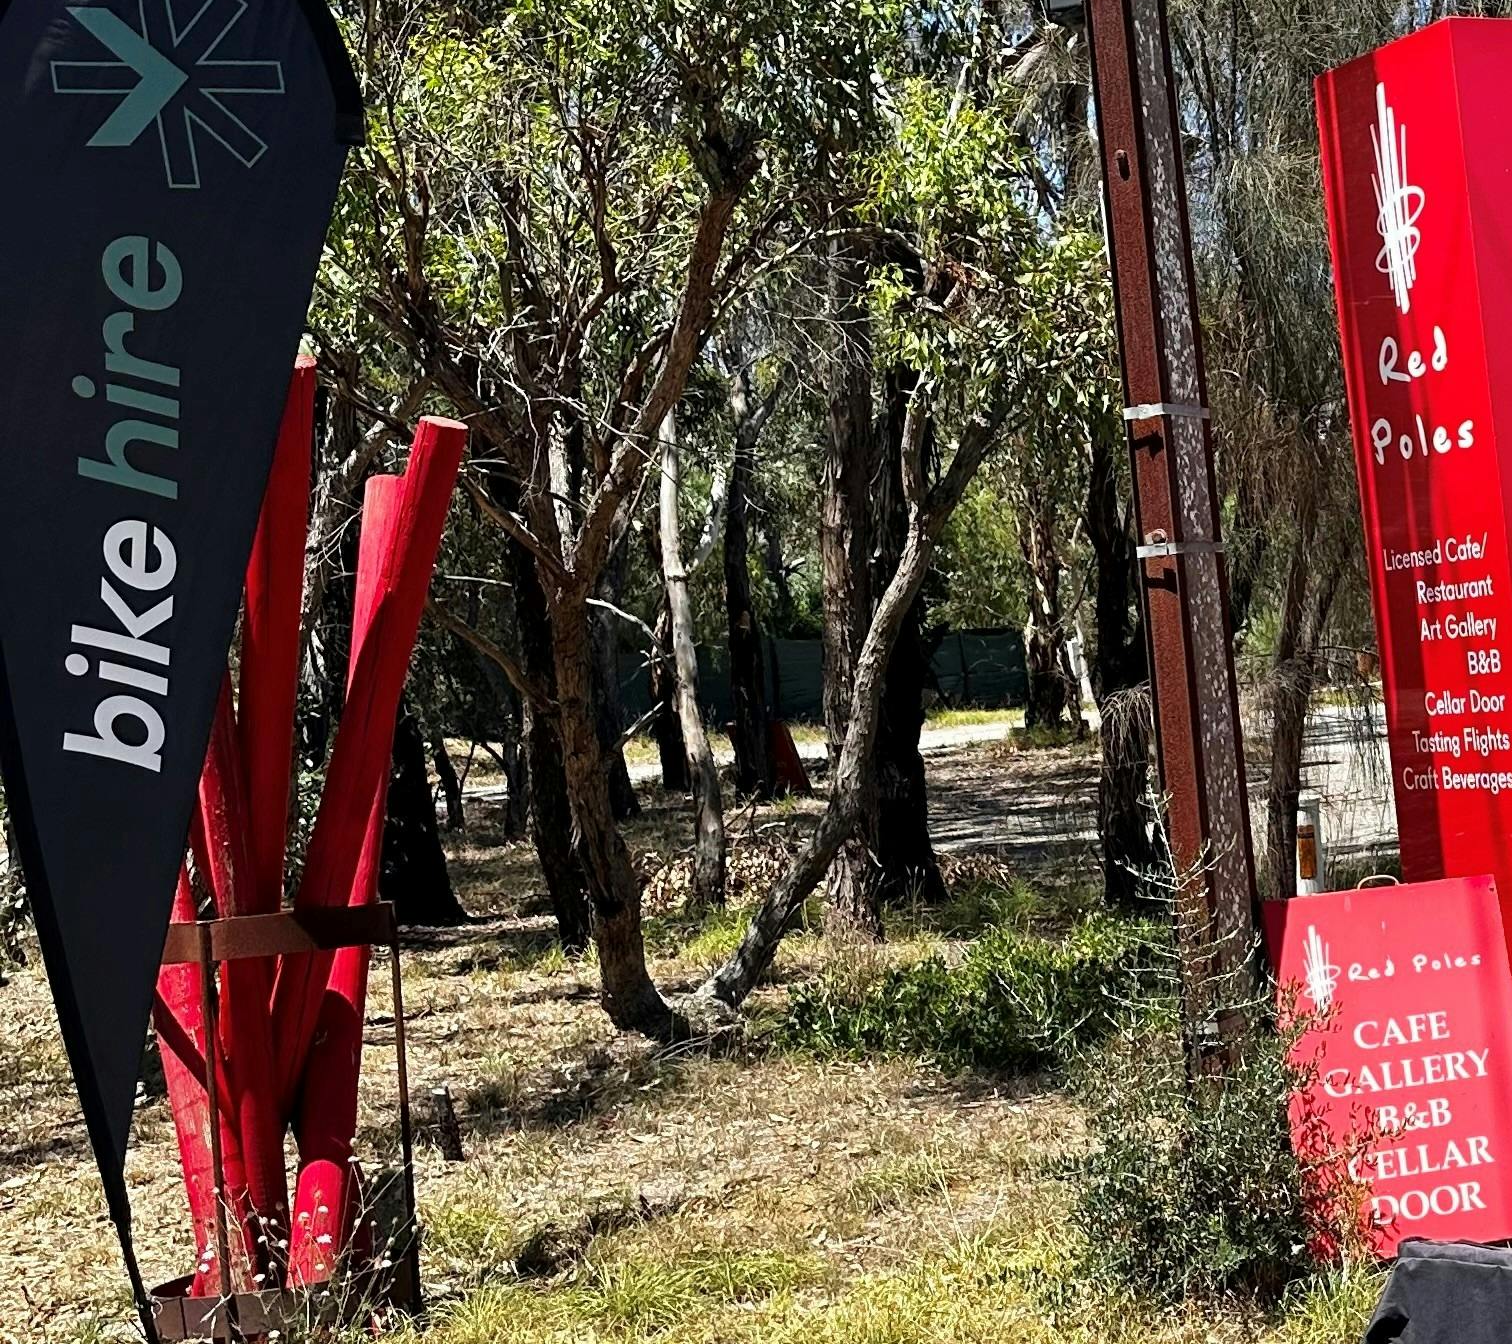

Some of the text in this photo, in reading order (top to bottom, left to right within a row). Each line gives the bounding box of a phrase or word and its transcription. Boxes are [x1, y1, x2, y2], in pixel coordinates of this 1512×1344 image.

[1378, 325, 1448, 386] Red
[1370, 414, 1475, 465] Poles
[63, 234, 184, 774] bike hire
[1383, 532, 1488, 572] Licensed Cafe/
[1416, 575, 1494, 605] Restaurant
[1420, 613, 1497, 643] Art Gallery
[1467, 649, 1502, 675] B&B
[1424, 689, 1506, 717] Cellar Door
[1411, 726, 1511, 757] Tasting Flights
[1403, 767, 1440, 790] Craft
[1347, 952, 1482, 983] Red Poles
[1352, 1010, 1451, 1050] CAFE
[1322, 1048, 1490, 1099] GALLERY
[1376, 1098, 1452, 1134] B&B
[1347, 1135, 1495, 1185] CELLAR
[1370, 1181, 1487, 1226] DOOR
